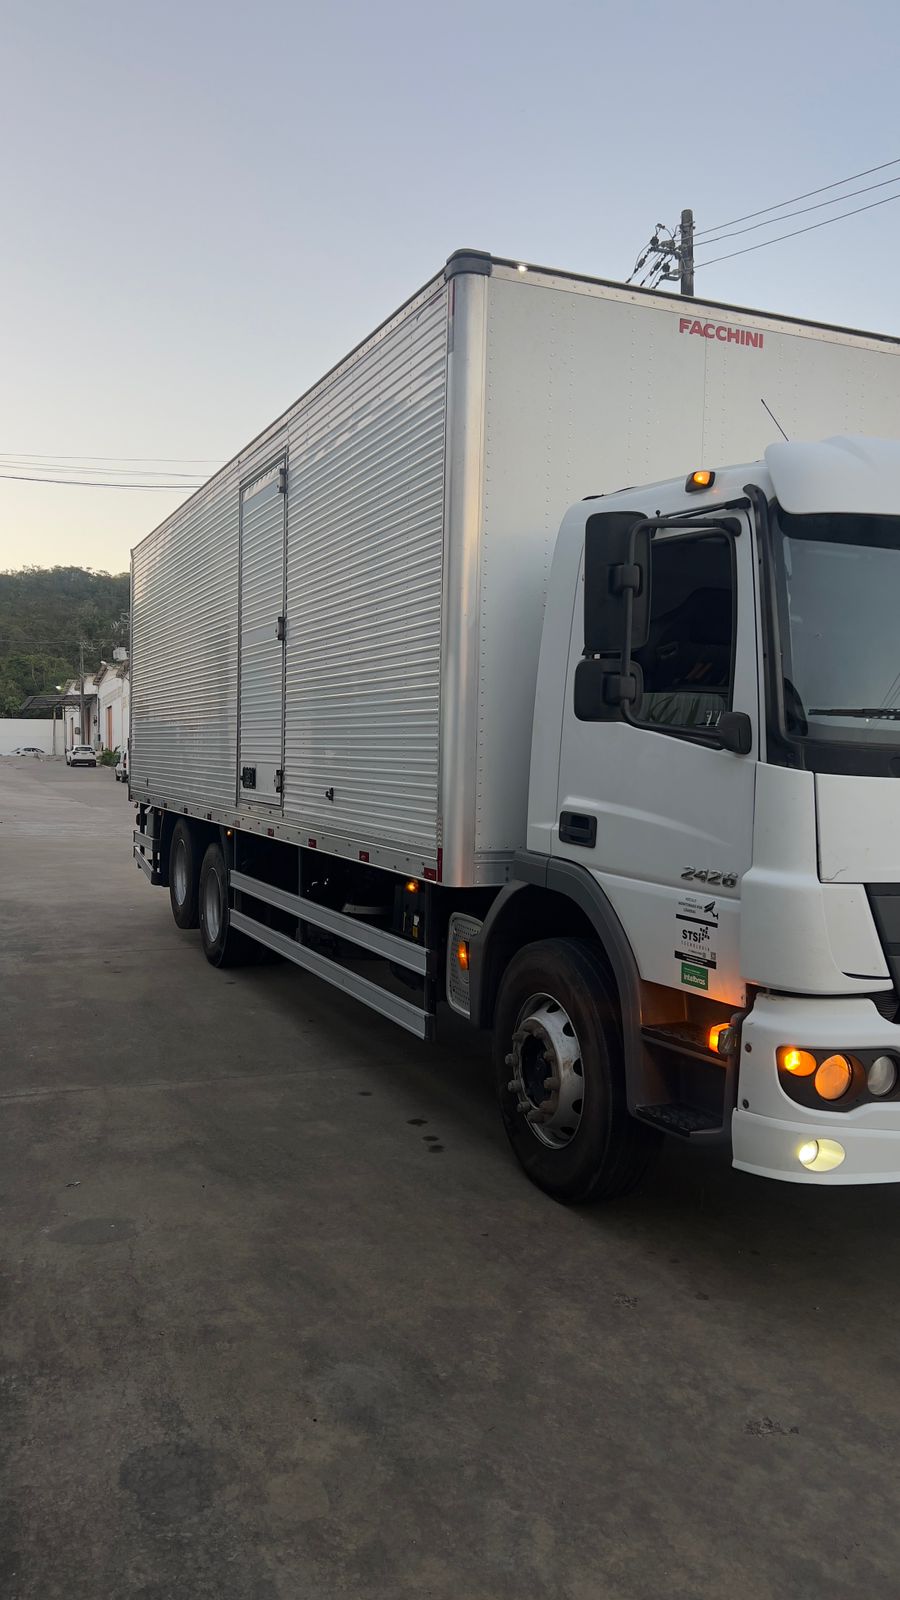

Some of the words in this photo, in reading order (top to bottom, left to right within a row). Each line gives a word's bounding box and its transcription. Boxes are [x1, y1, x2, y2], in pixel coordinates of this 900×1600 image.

[679, 318, 764, 348] FACCHINI
[680, 865, 739, 889] 2426
[683, 973, 706, 986] intelbras
